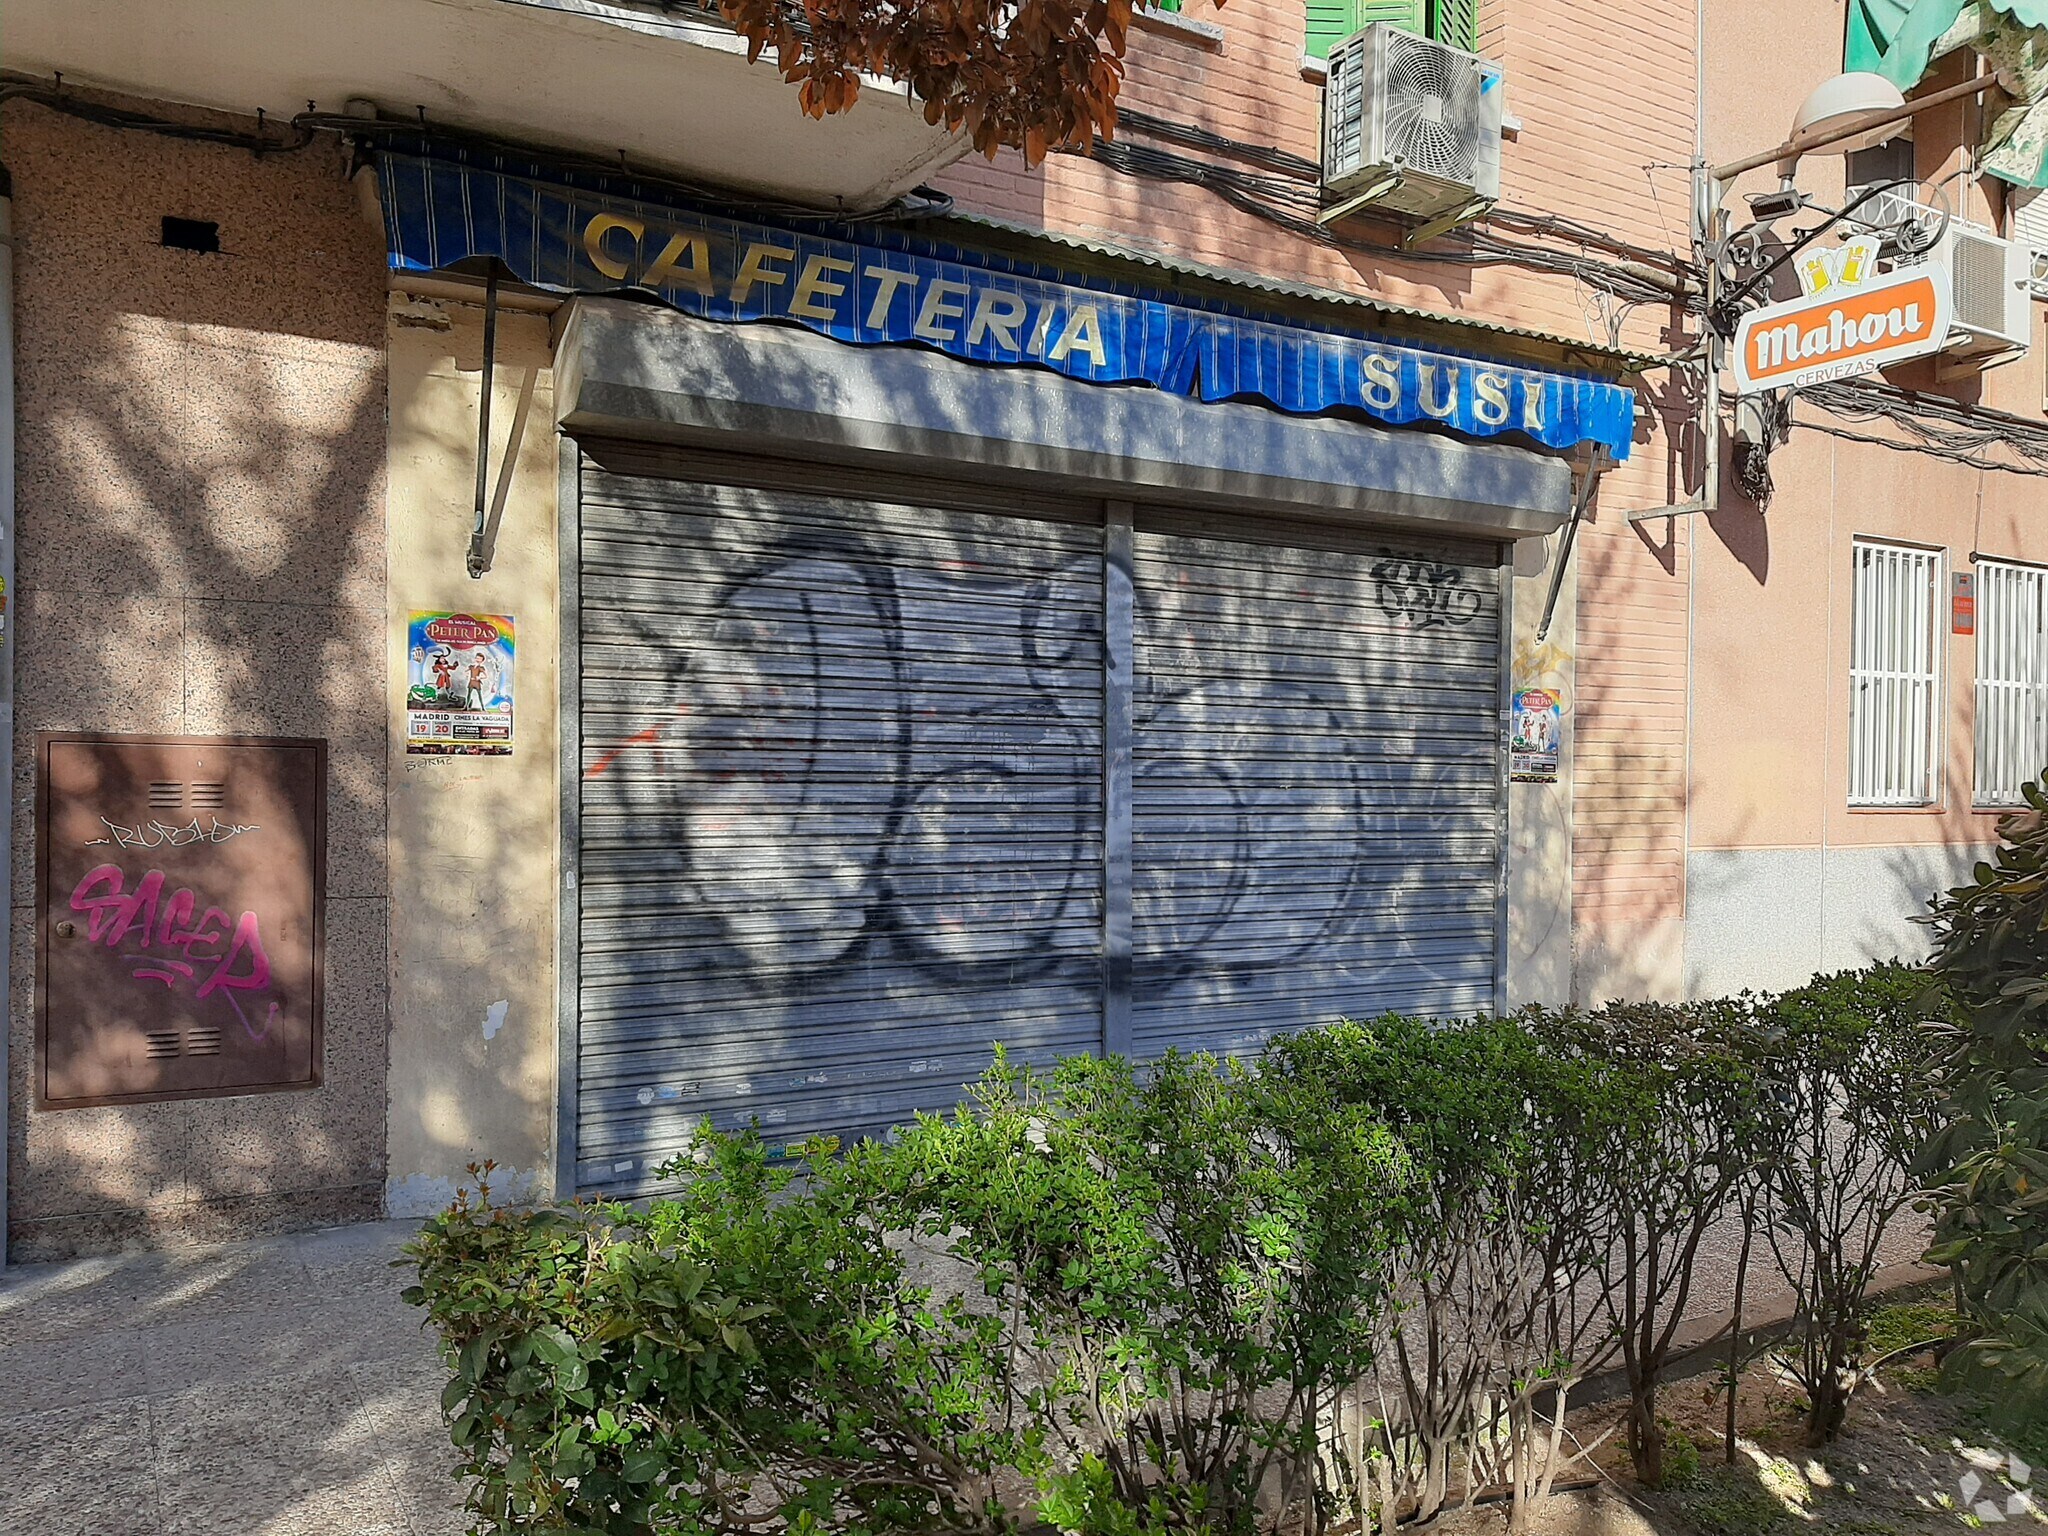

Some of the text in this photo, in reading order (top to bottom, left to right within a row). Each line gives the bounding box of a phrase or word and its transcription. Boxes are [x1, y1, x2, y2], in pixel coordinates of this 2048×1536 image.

[582, 212, 1544, 431] CAFETERIA SUSI
[1753, 301, 1924, 371] Mahou
[1795, 358, 1876, 388] CERVEZAS
[430, 624, 496, 640] PETER PAN
[413, 713, 450, 721] MADRID
[415, 724, 449, 733] 19 20
